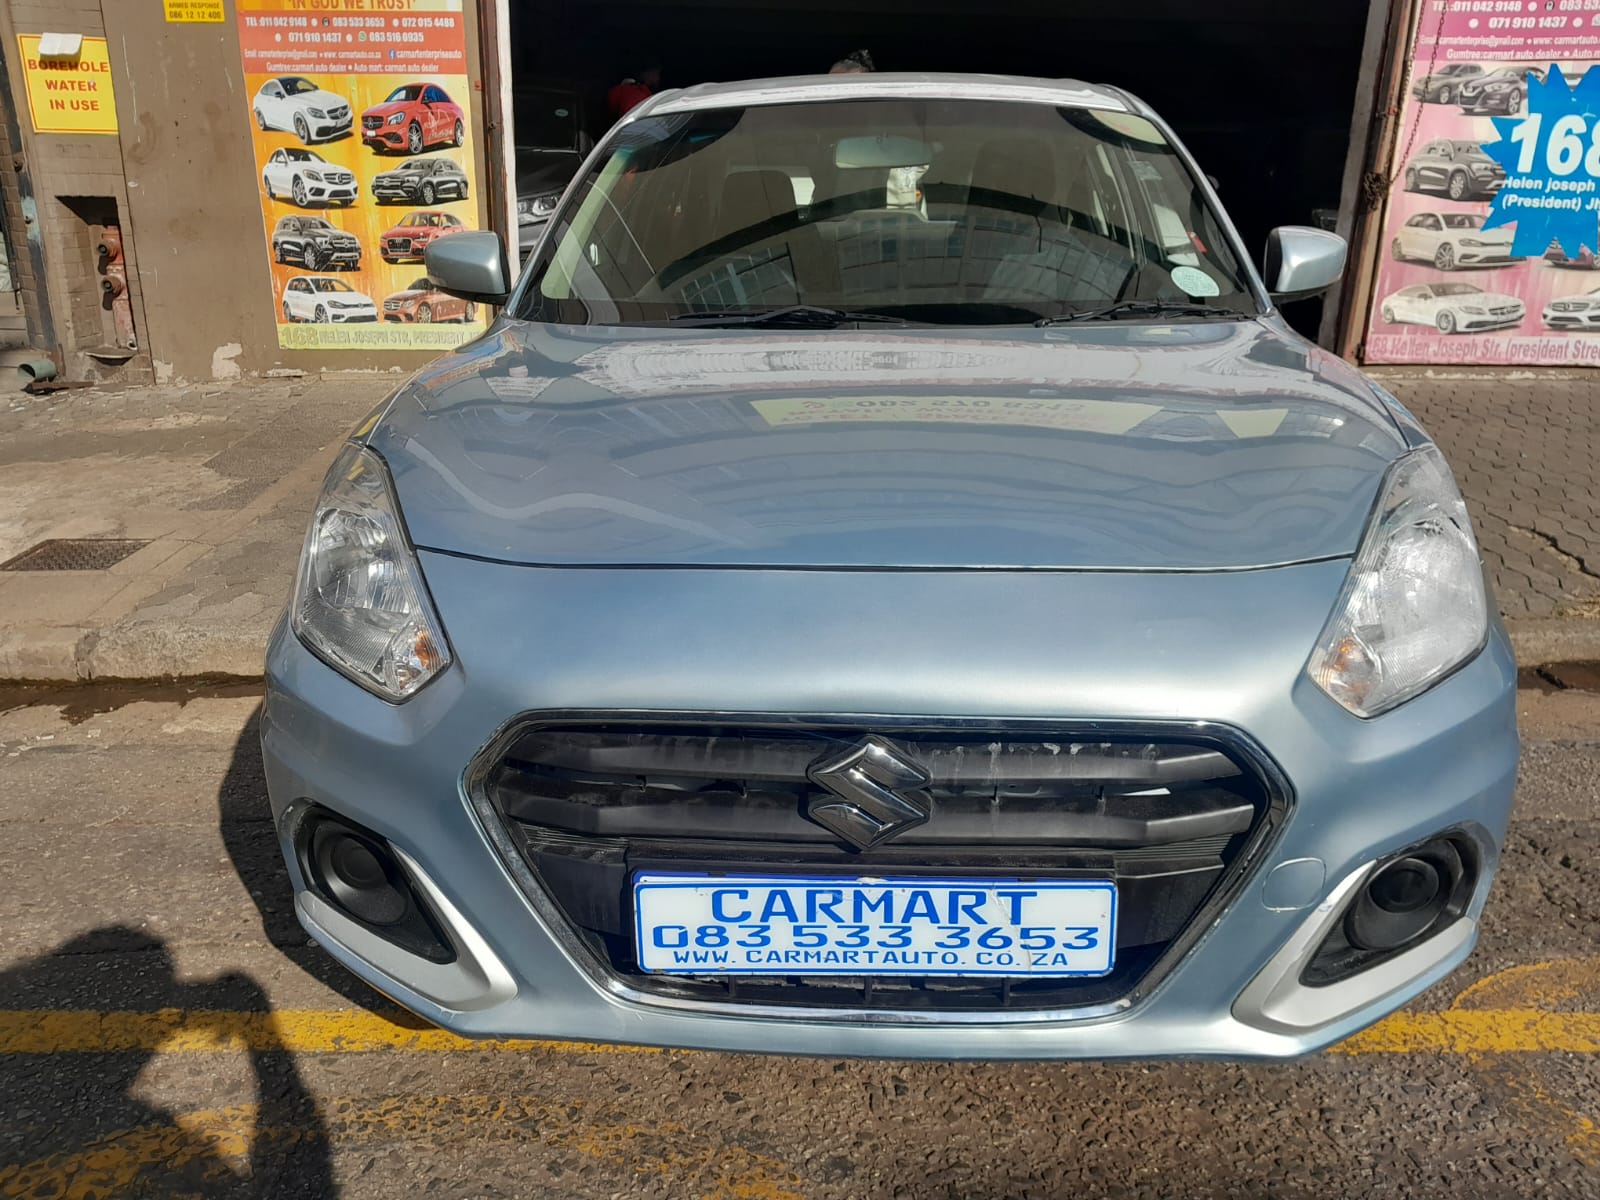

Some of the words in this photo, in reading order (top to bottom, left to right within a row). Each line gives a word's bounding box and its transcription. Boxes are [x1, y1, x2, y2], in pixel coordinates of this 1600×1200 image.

[1472, 1, 1494, 12] 042
[1495, 1, 1522, 12] 9148
[1559, 0, 1583, 11] 083
[1488, 17, 1511, 29] 071
[1512, 17, 1536, 29] 910
[1538, 16, 1568, 28] 1437
[288, 32, 304, 43] 071
[1515, 49, 1534, 59] auto
[1535, 49, 1562, 59] dealer
[28, 59, 109, 72] BOREHOLE
[45, 79, 97, 92] WATER
[49, 98, 65, 110] IN
[69, 99, 99, 111] USE
[1502, 175, 1543, 189] Helen
[1502, 193, 1582, 213] (President)
[281, 326, 319, 346] 168
[1432, 336, 1478, 361] Joseph
[711, 888, 1038, 925] CARMART
[652, 925, 771, 949] 083
[792, 925, 913, 949] 533
[934, 926, 1099, 951] 3653
